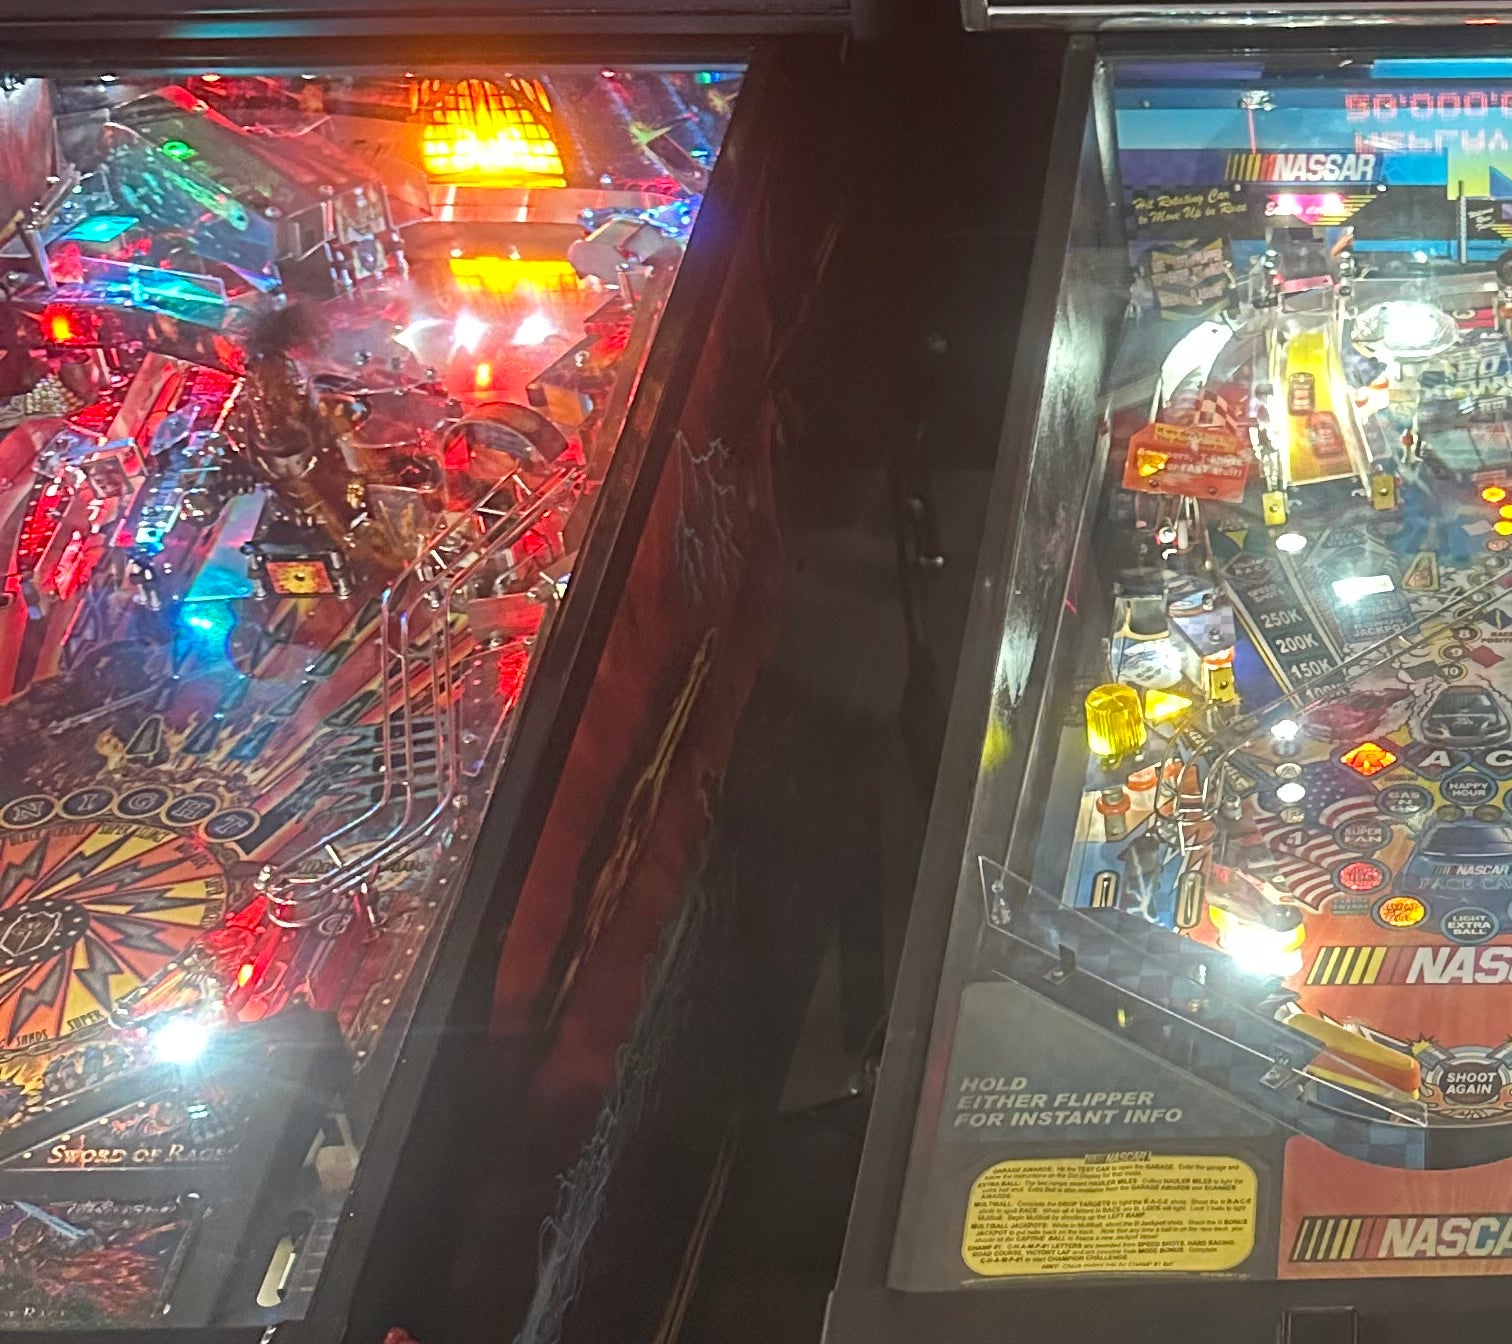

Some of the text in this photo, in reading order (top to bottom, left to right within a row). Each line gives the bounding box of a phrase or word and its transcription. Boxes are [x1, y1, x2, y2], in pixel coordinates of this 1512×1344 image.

[1208, 187, 1230, 203] Car
[1260, 608, 1303, 629] 250K
[1275, 632, 1319, 654] 200K
[1291, 658, 1335, 680] 150K
[1442, 667, 1459, 676] 10
[1417, 751, 1450, 767] A
[1449, 782, 1489, 790] HAPPY
[1452, 789, 1486, 797] HOUR
[1388, 791, 1420, 799] GAS
[1456, 865, 1510, 875] NASCAR
[1419, 878, 1474, 890] PACE
[67, 1009, 104, 1030] SUPER
[960, 1077, 1028, 1092] HOLD
[1445, 1072, 1497, 1083] SHOOT
[1446, 1083, 1494, 1095] AGAIN
[955, 1091, 1155, 1110] EITHER FLIPPER
[953, 1108, 1183, 1127] FOR INSTANT INFO
